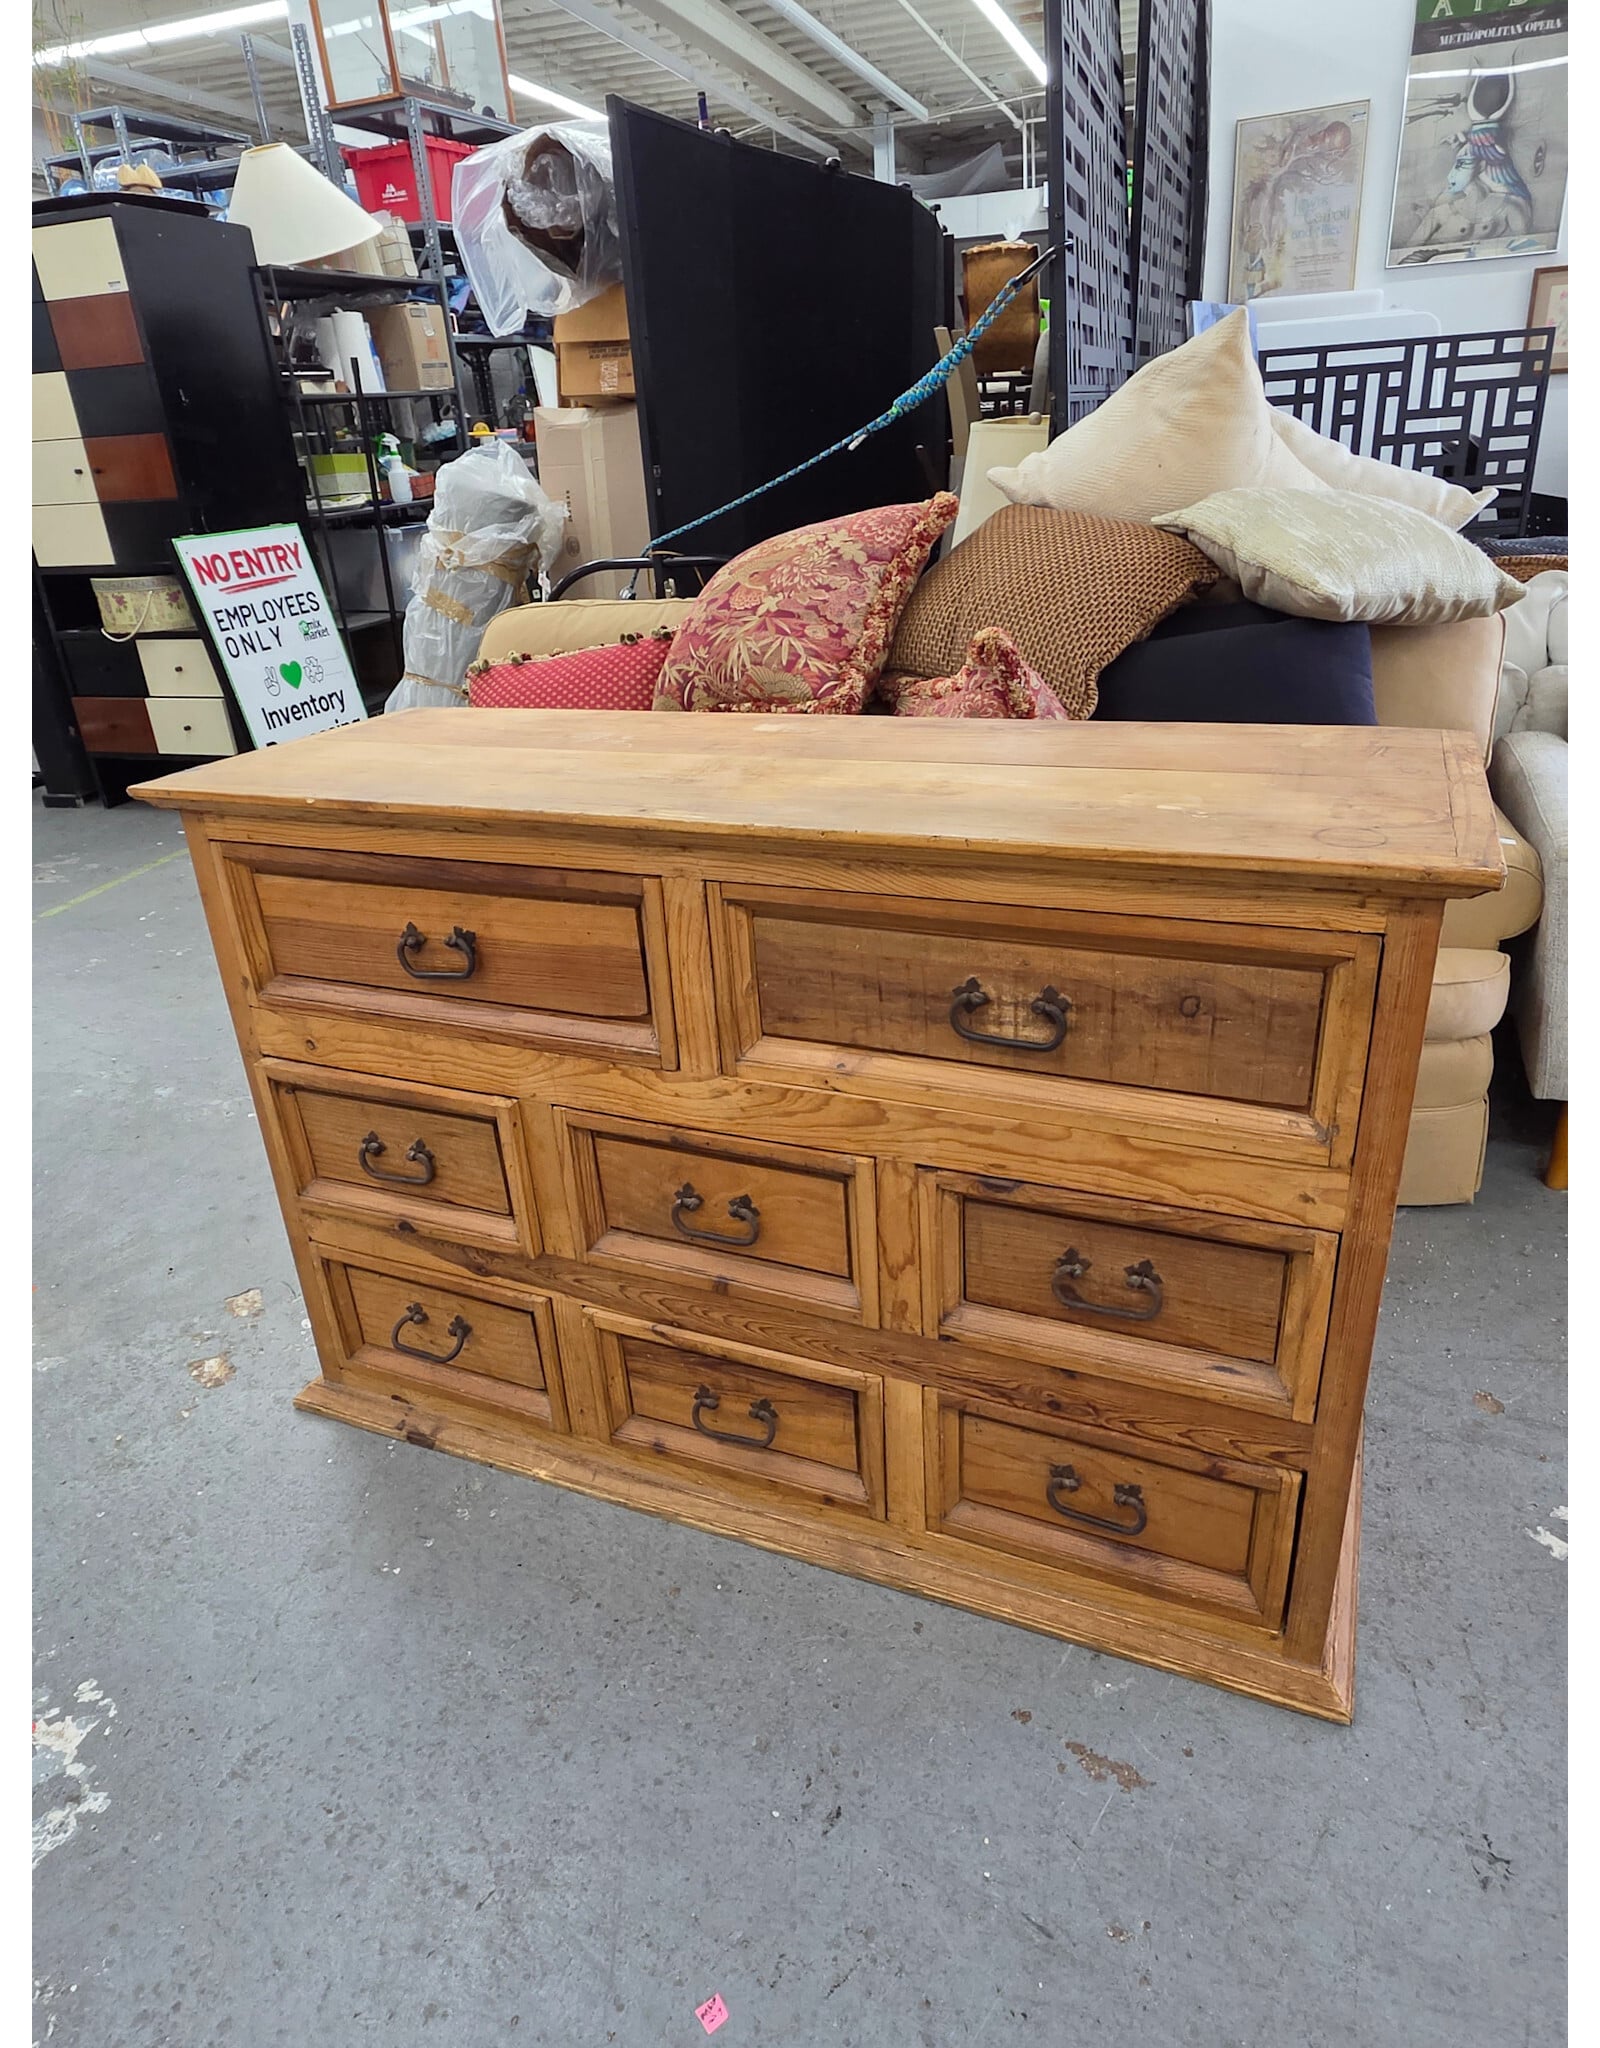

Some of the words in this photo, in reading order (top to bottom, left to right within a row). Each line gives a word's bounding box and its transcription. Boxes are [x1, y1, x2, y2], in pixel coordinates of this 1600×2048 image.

[1439, 24, 1522, 47] METROPOLITAN
[1525, 18, 1562, 33] OPERA
[191, 553, 231, 586] NO
[228, 542, 303, 580] ENTRY
[212, 591, 321, 632] EMPLOYEES
[224, 625, 284, 659] ONLY
[261, 689, 346, 730] Inventory
